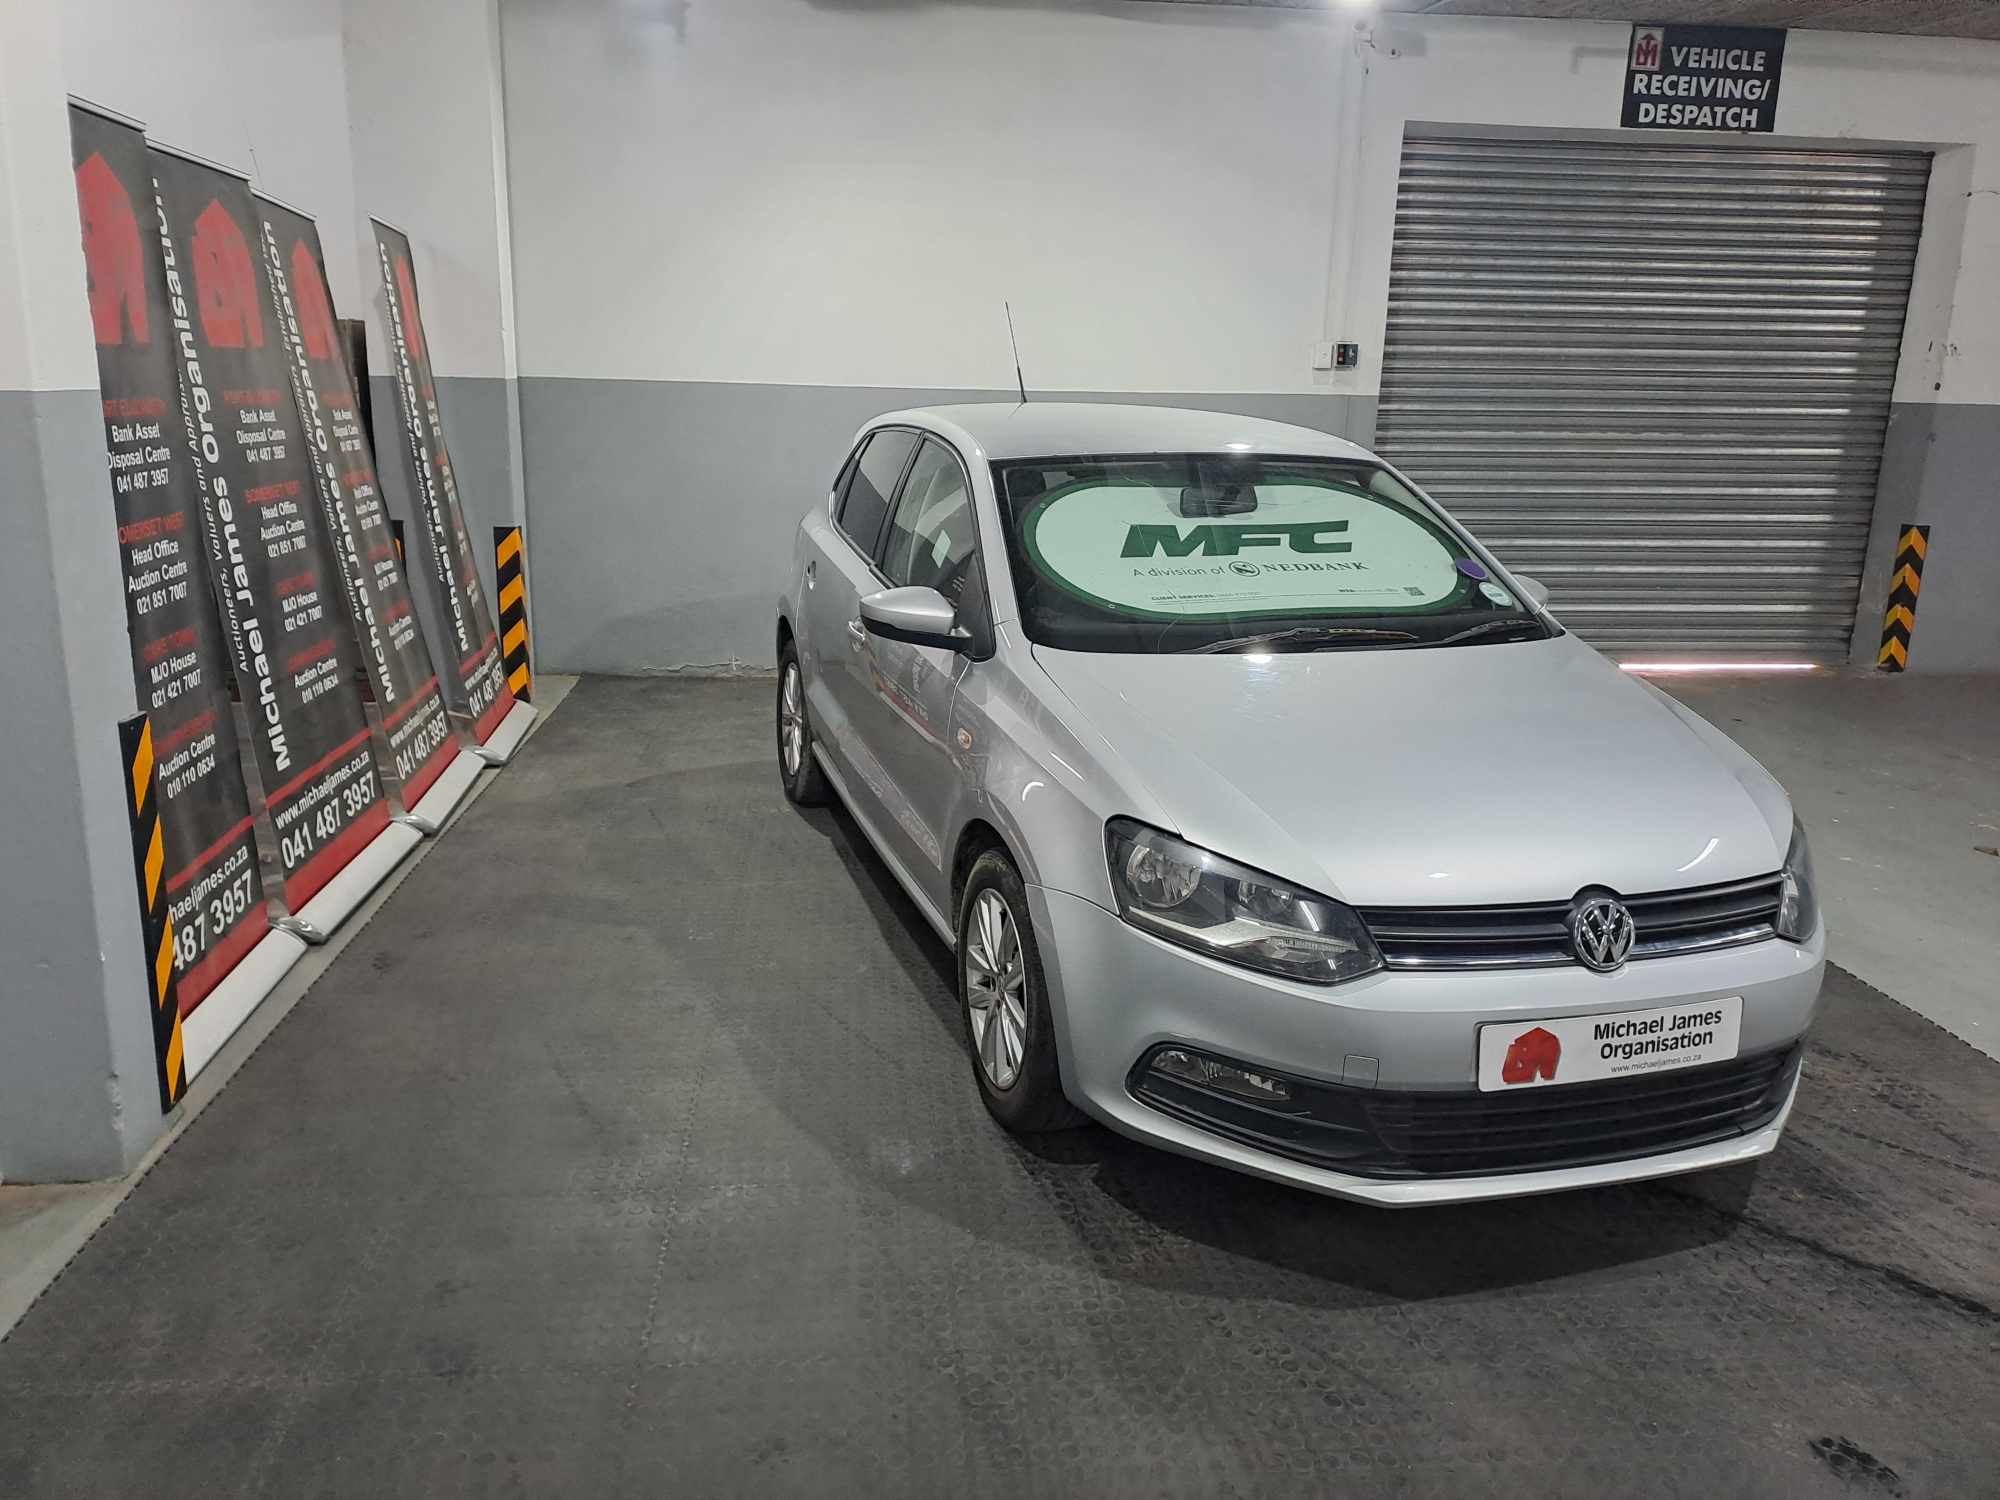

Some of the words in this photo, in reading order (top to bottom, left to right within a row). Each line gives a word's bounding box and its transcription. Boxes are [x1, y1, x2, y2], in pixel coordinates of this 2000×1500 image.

[1670, 46, 1766, 72] VEHICLE
[1633, 73, 1771, 101] RECEIVING/
[1638, 102, 1759, 129] DESPATCH
[263, 220, 328, 452] Organisation
[112, 423, 134, 442] Bank
[136, 422, 160, 440] Asset
[240, 409, 258, 423] Bank
[236, 428, 267, 446] Disposal
[145, 446, 171, 463] Centre
[117, 474, 132, 493] 041
[134, 471, 148, 489] 487
[151, 468, 168, 487] 3957
[192, 456, 207, 491] and
[203, 496, 223, 561] Valuers
[261, 504, 278, 520] Head
[325, 462, 360, 568] James
[213, 477, 254, 607] James
[261, 524, 286, 540] Auction
[1120, 520, 1352, 558] MFC
[131, 544, 152, 566] Head
[154, 540, 179, 558] Office
[1133, 568, 1143, 577] A
[1148, 564, 1207, 577] division
[1211, 565, 1225, 576] of
[1263, 561, 1369, 572] NEDBANK
[128, 570, 160, 592] Auction
[162, 561, 188, 580] Centre
[137, 595, 151, 615] 021
[152, 588, 167, 608] 851
[168, 581, 187, 602] 7007
[219, 567, 248, 672] Auctioneers,
[354, 577, 395, 703] Michael
[151, 662, 168, 684] MJO
[170, 652, 196, 674] House
[295, 667, 317, 688] Auction
[152, 688, 166, 708] 021
[167, 678, 182, 699] 421
[183, 668, 200, 691] 7007
[243, 617, 291, 772] Michael
[159, 750, 190, 780] Auction
[190, 734, 215, 757] Centre
[396, 745, 415, 780] 041
[414, 729, 430, 761] 487
[428, 710, 447, 746] 3957
[167, 777, 181, 799] 010
[181, 766, 196, 787] 110
[197, 753, 215, 777] 0634
[275, 750, 370, 829] www.michaeljames.co.za
[281, 822, 313, 869] 041
[316, 798, 341, 839] 487
[343, 771, 376, 817] 3957
[210, 869, 252, 935] 3957
[1593, 1016, 1664, 1040] Michael
[1668, 1010, 1722, 1031] James
[1600, 1031, 1713, 1060] Organisation
